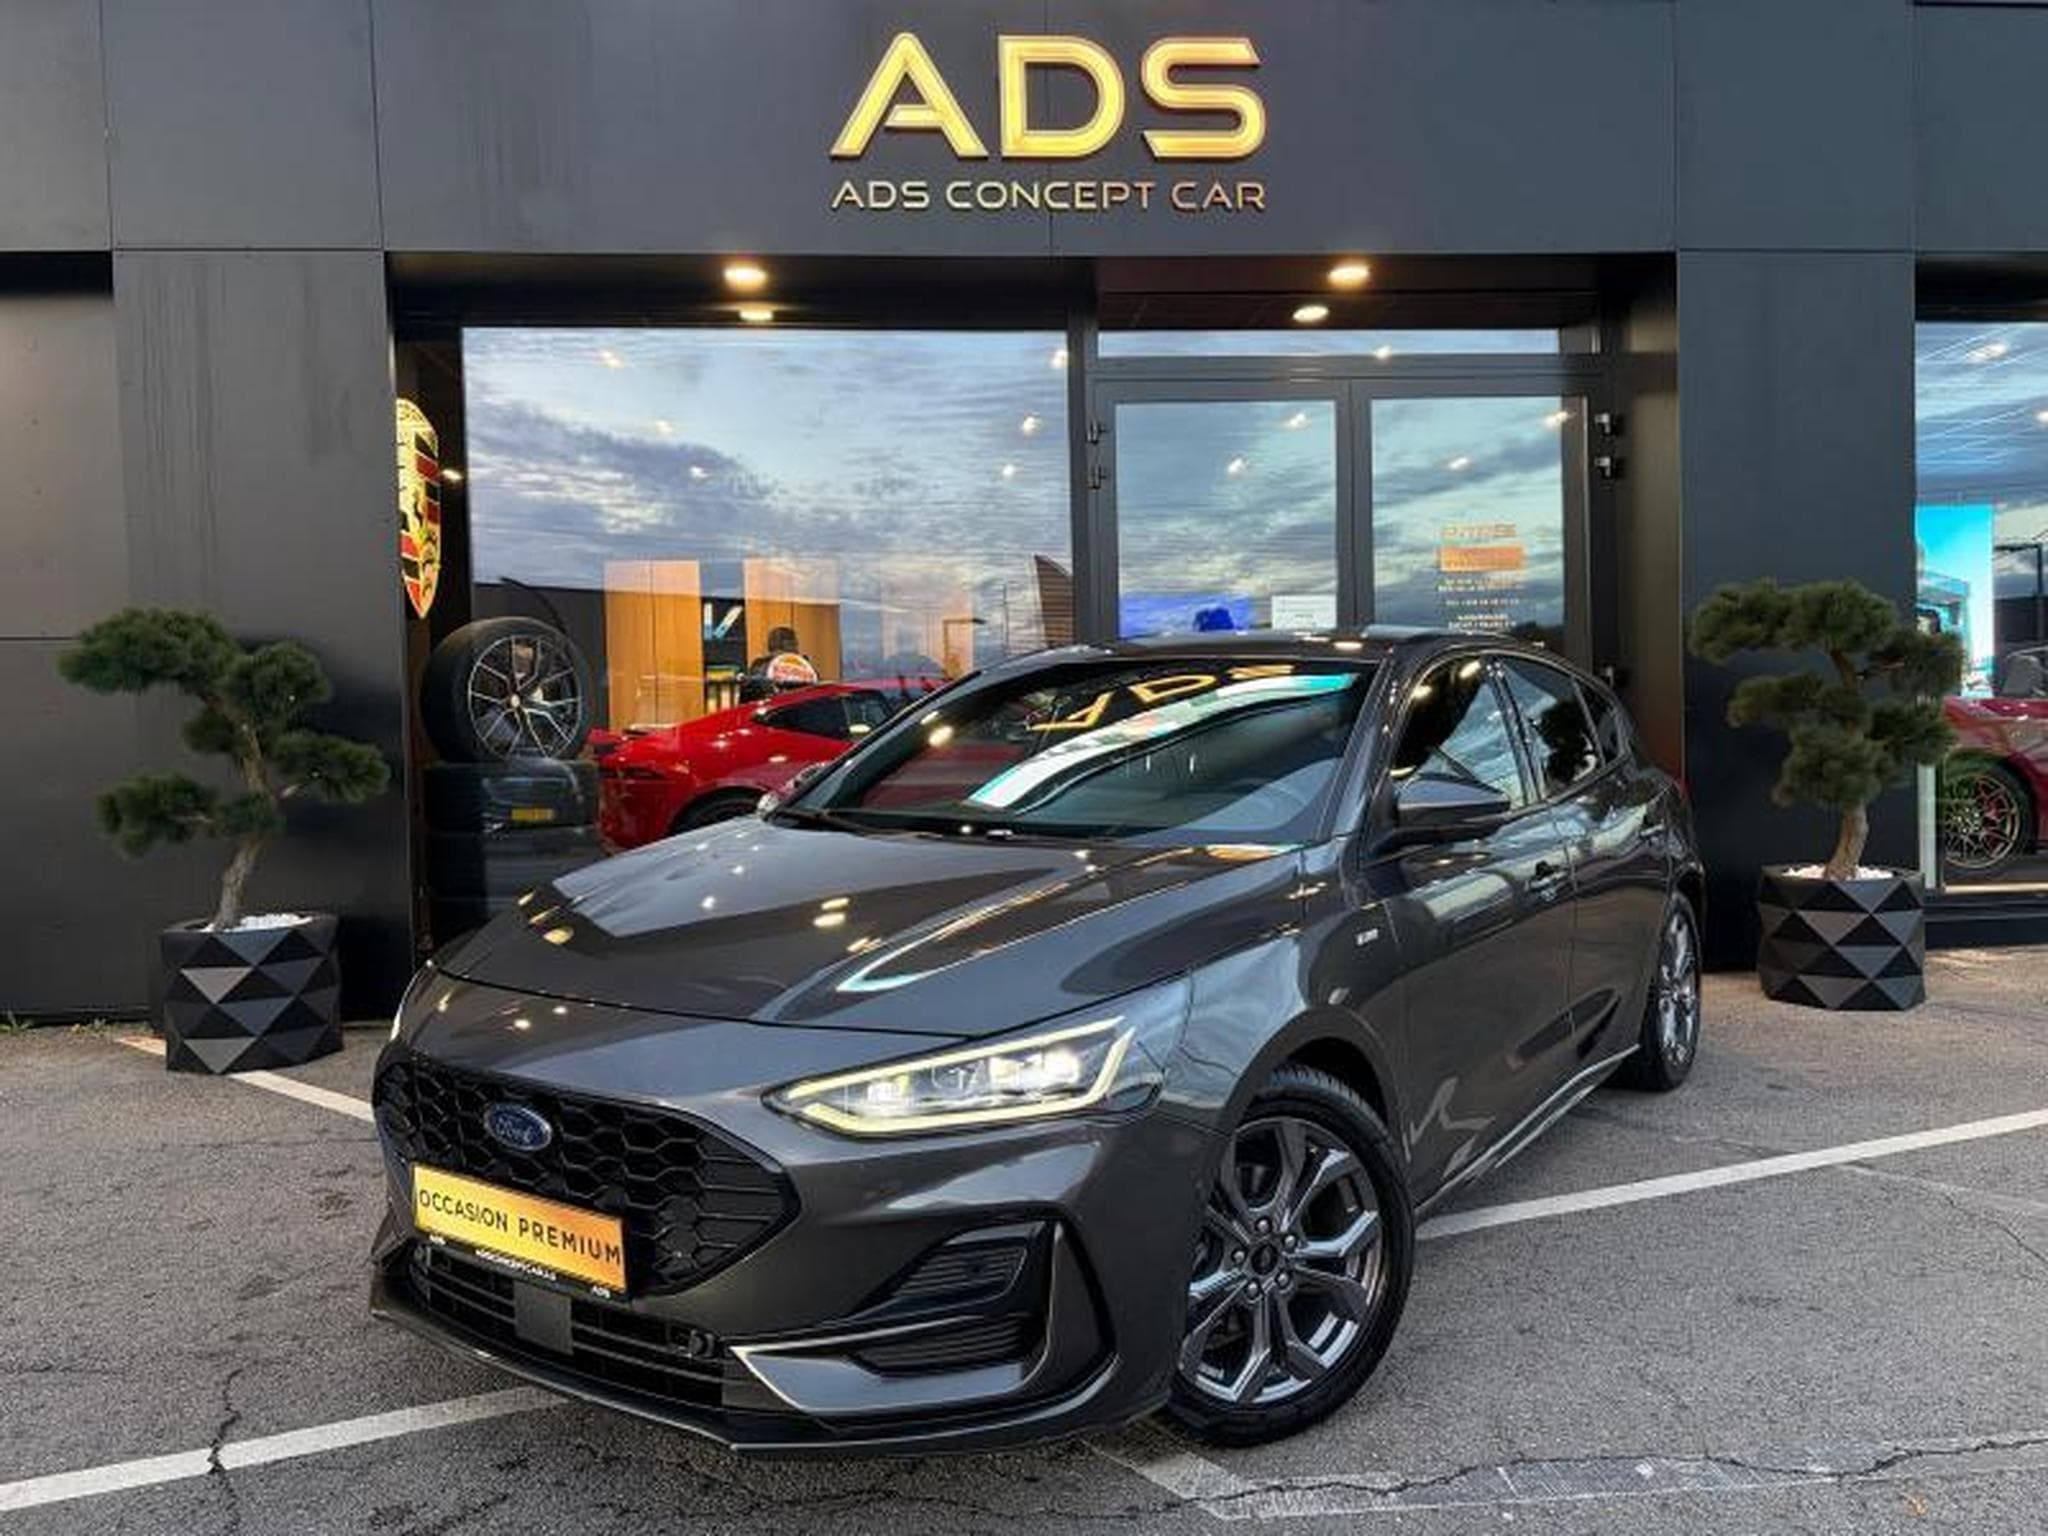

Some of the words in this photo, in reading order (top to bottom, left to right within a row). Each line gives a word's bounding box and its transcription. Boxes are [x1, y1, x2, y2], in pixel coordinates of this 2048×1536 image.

[829, 31, 1267, 159] ADS
[831, 180, 930, 209] ADS
[946, 180, 1156, 210] CONCEPT
[1171, 181, 1266, 210] CAR
[419, 1189, 508, 1232] OCCASION
[518, 1217, 621, 1266] PREMIUM
